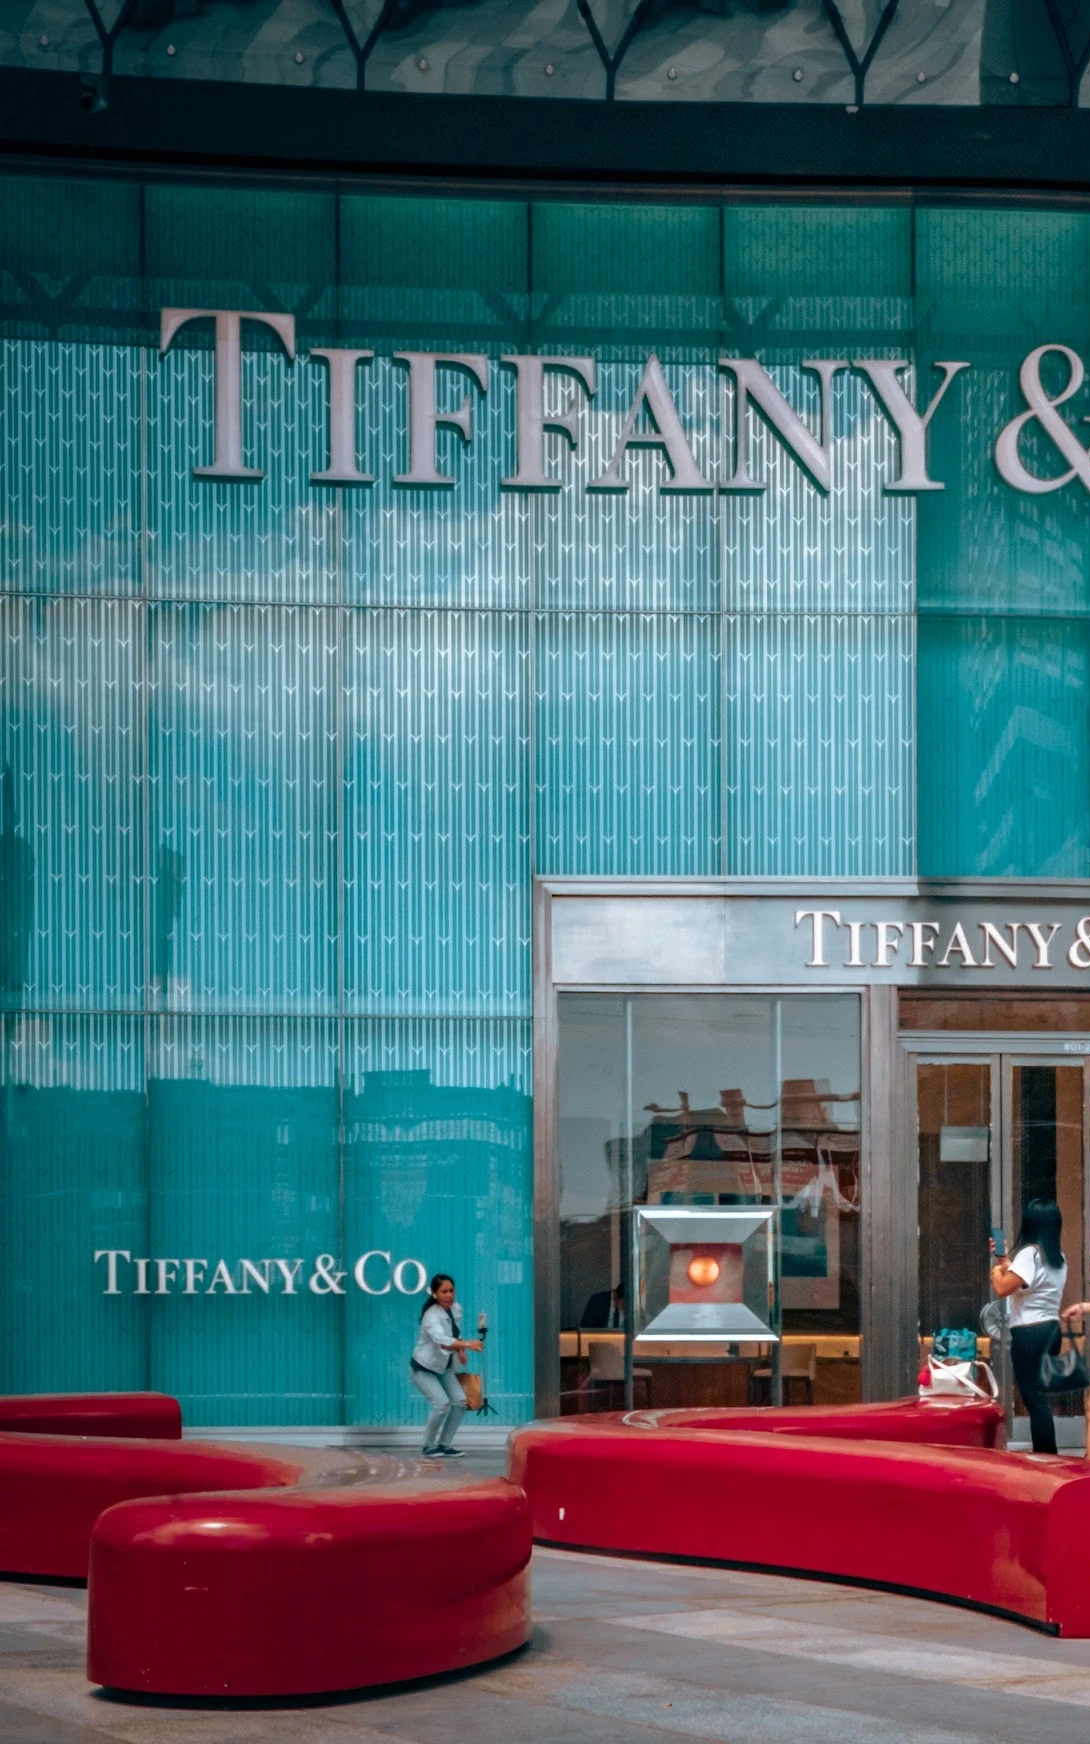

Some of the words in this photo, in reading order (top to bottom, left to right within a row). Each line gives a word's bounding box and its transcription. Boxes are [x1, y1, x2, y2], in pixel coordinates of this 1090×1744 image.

[160, 307, 971, 494] TIFFANY
[795, 910, 1061, 968] TIFFANY
[94, 1249, 303, 1295] TIFFANY
[309, 1253, 347, 1295] &
